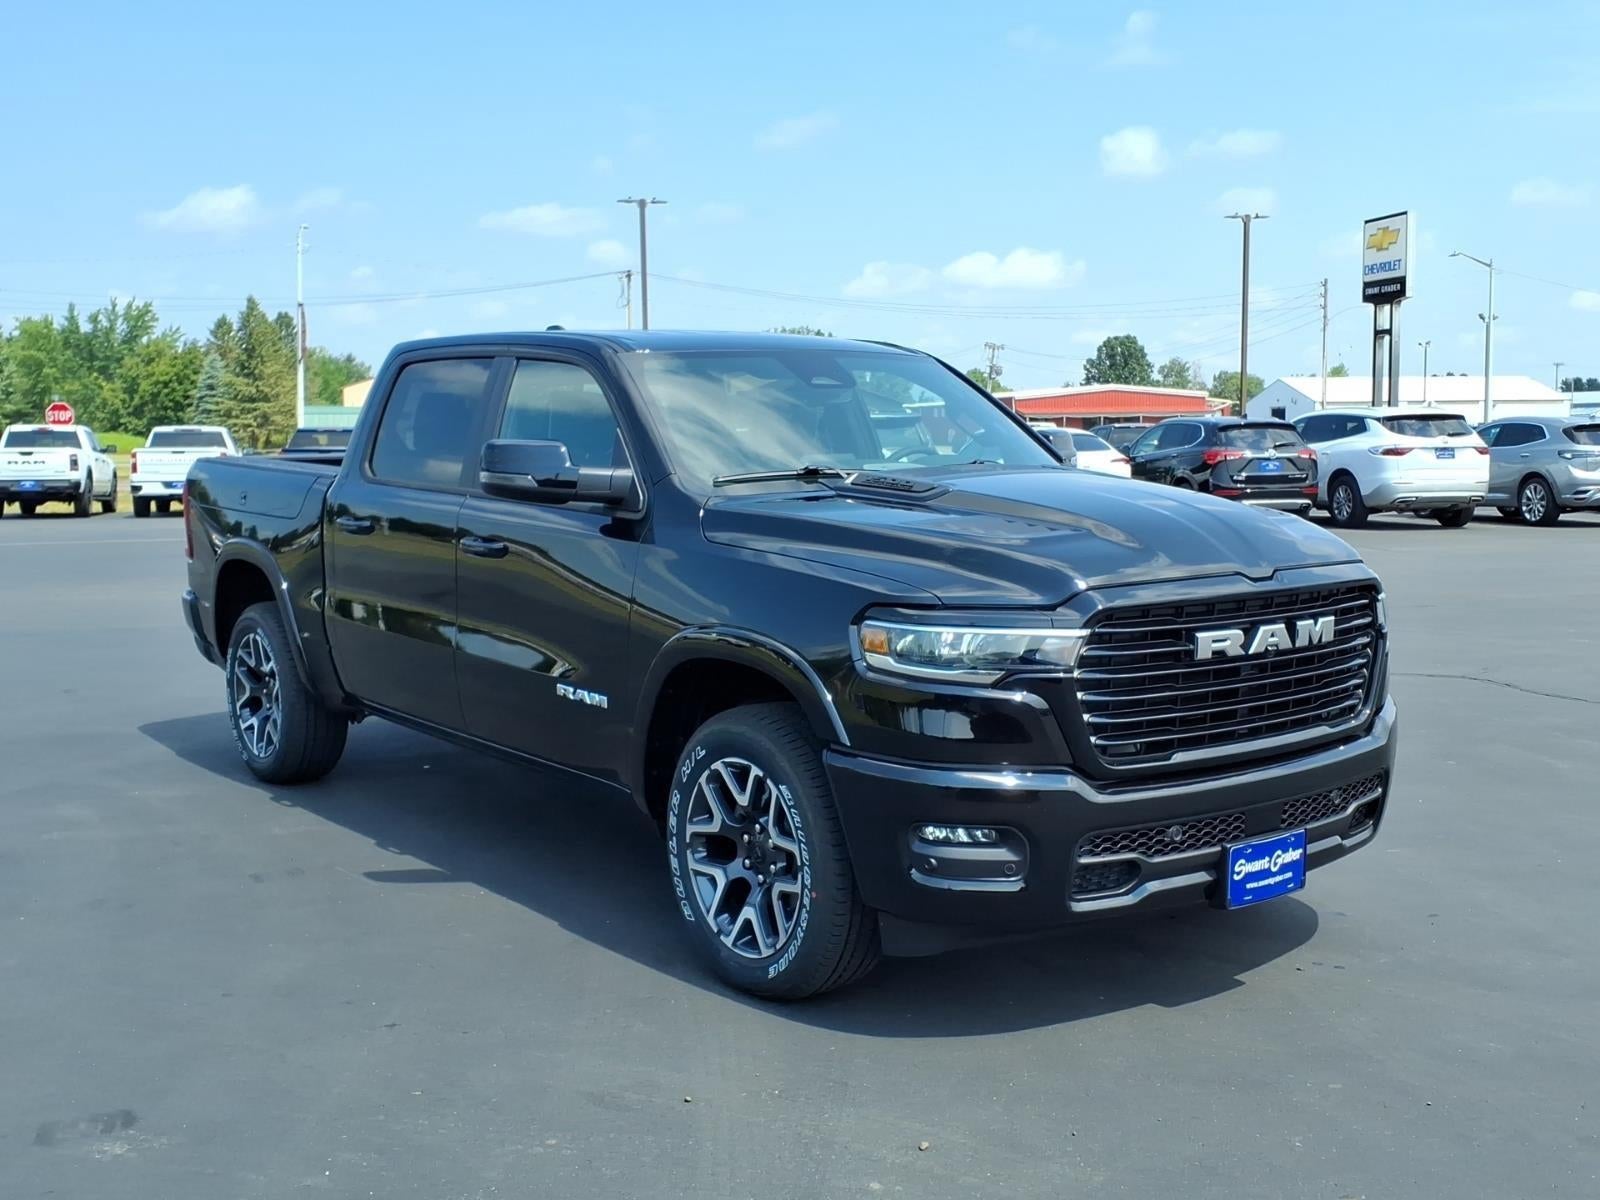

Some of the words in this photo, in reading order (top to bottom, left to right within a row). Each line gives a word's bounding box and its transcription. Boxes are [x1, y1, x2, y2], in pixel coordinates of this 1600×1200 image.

[1364, 258, 1402, 276] CHEVROLET
[47, 410, 72, 422] STOP
[1194, 615, 1336, 661] RAM
[556, 683, 608, 709] RAM
[668, 789, 695, 921] DUELER
[1233, 855, 1270, 881] Swant
[1270, 847, 1303, 873] Graber
